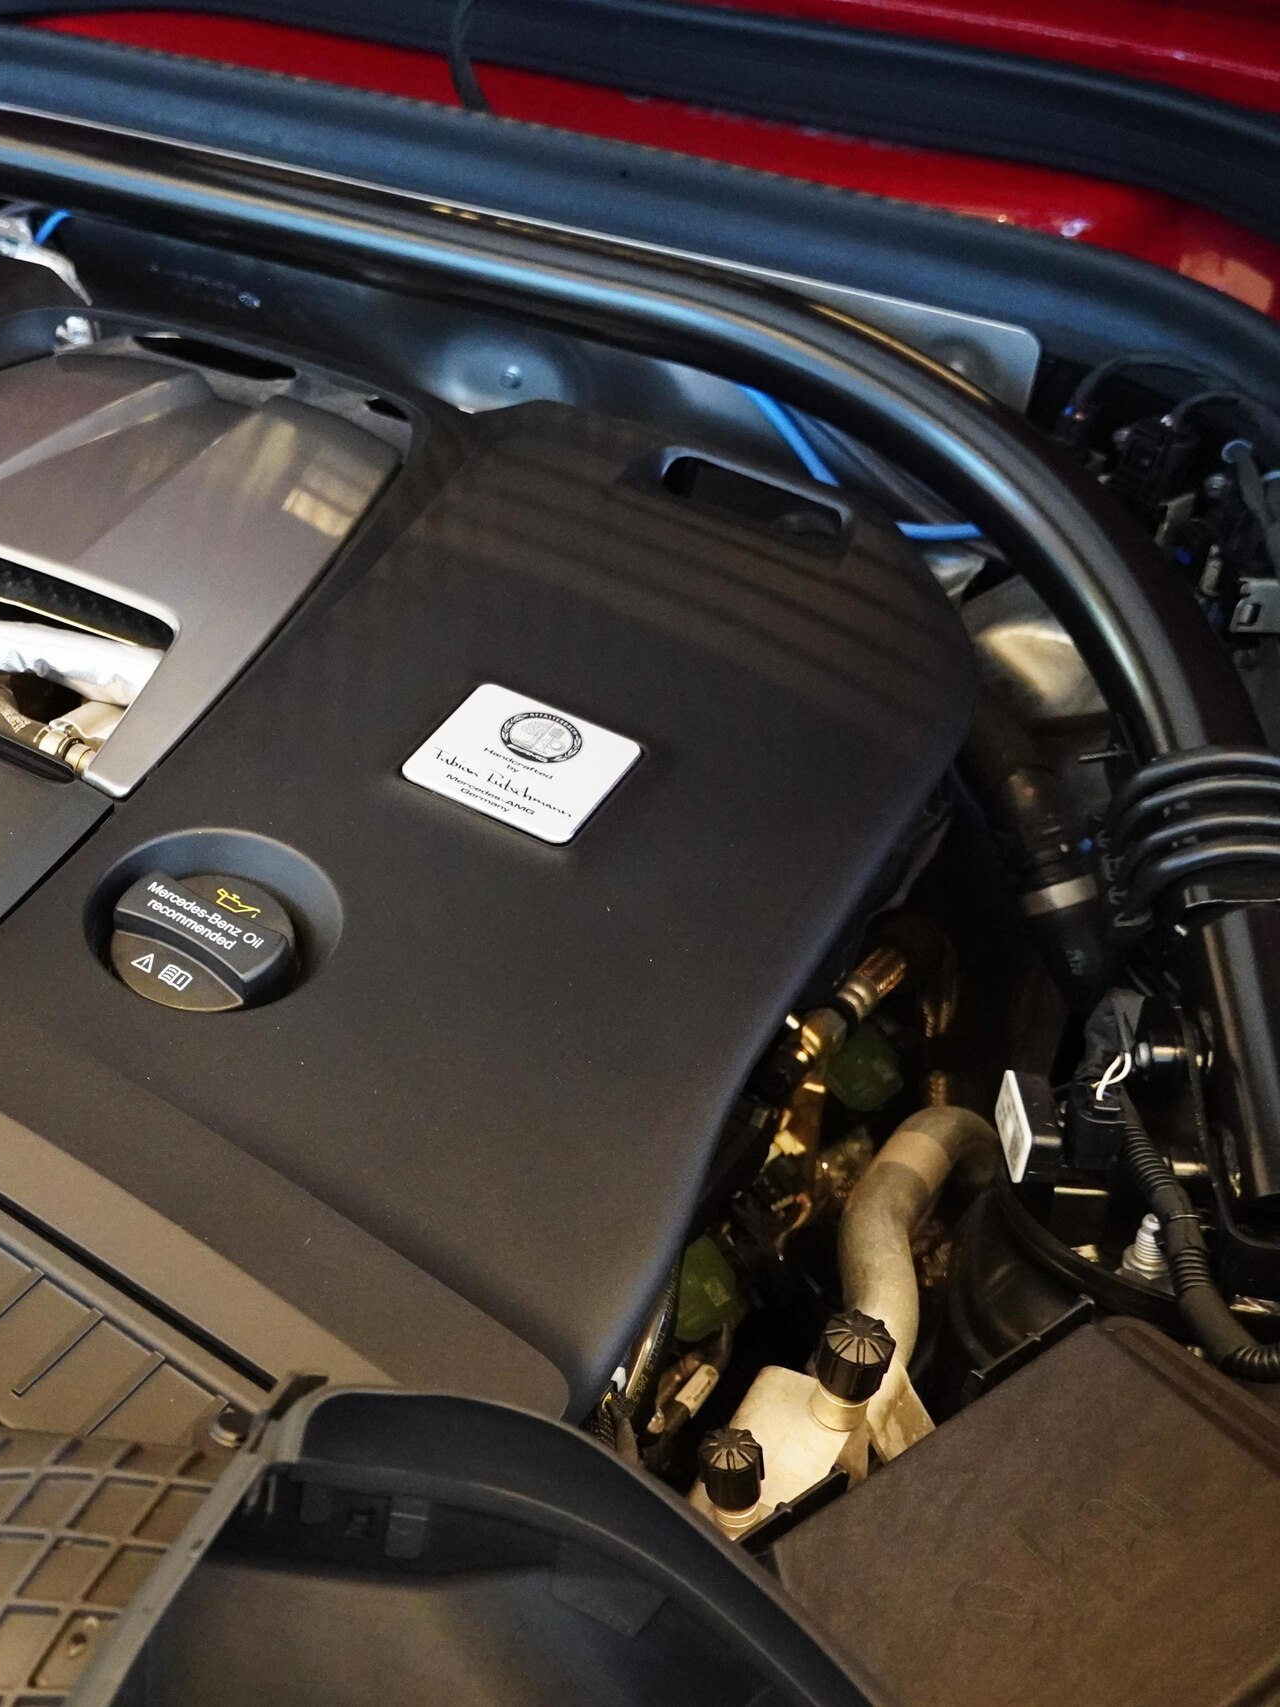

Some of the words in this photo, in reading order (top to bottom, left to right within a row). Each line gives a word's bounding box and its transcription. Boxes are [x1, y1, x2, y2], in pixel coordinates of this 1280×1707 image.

[484, 747, 554, 780] Handcrafted
[506, 764, 520, 774] by
[446, 773, 536, 816] Mercedes-AMG
[460, 787, 511, 813] Germany
[147, 881, 243, 937] Mercedes-Benz
[242, 931, 265, 949] Oil
[147, 898, 237, 951] recommended
